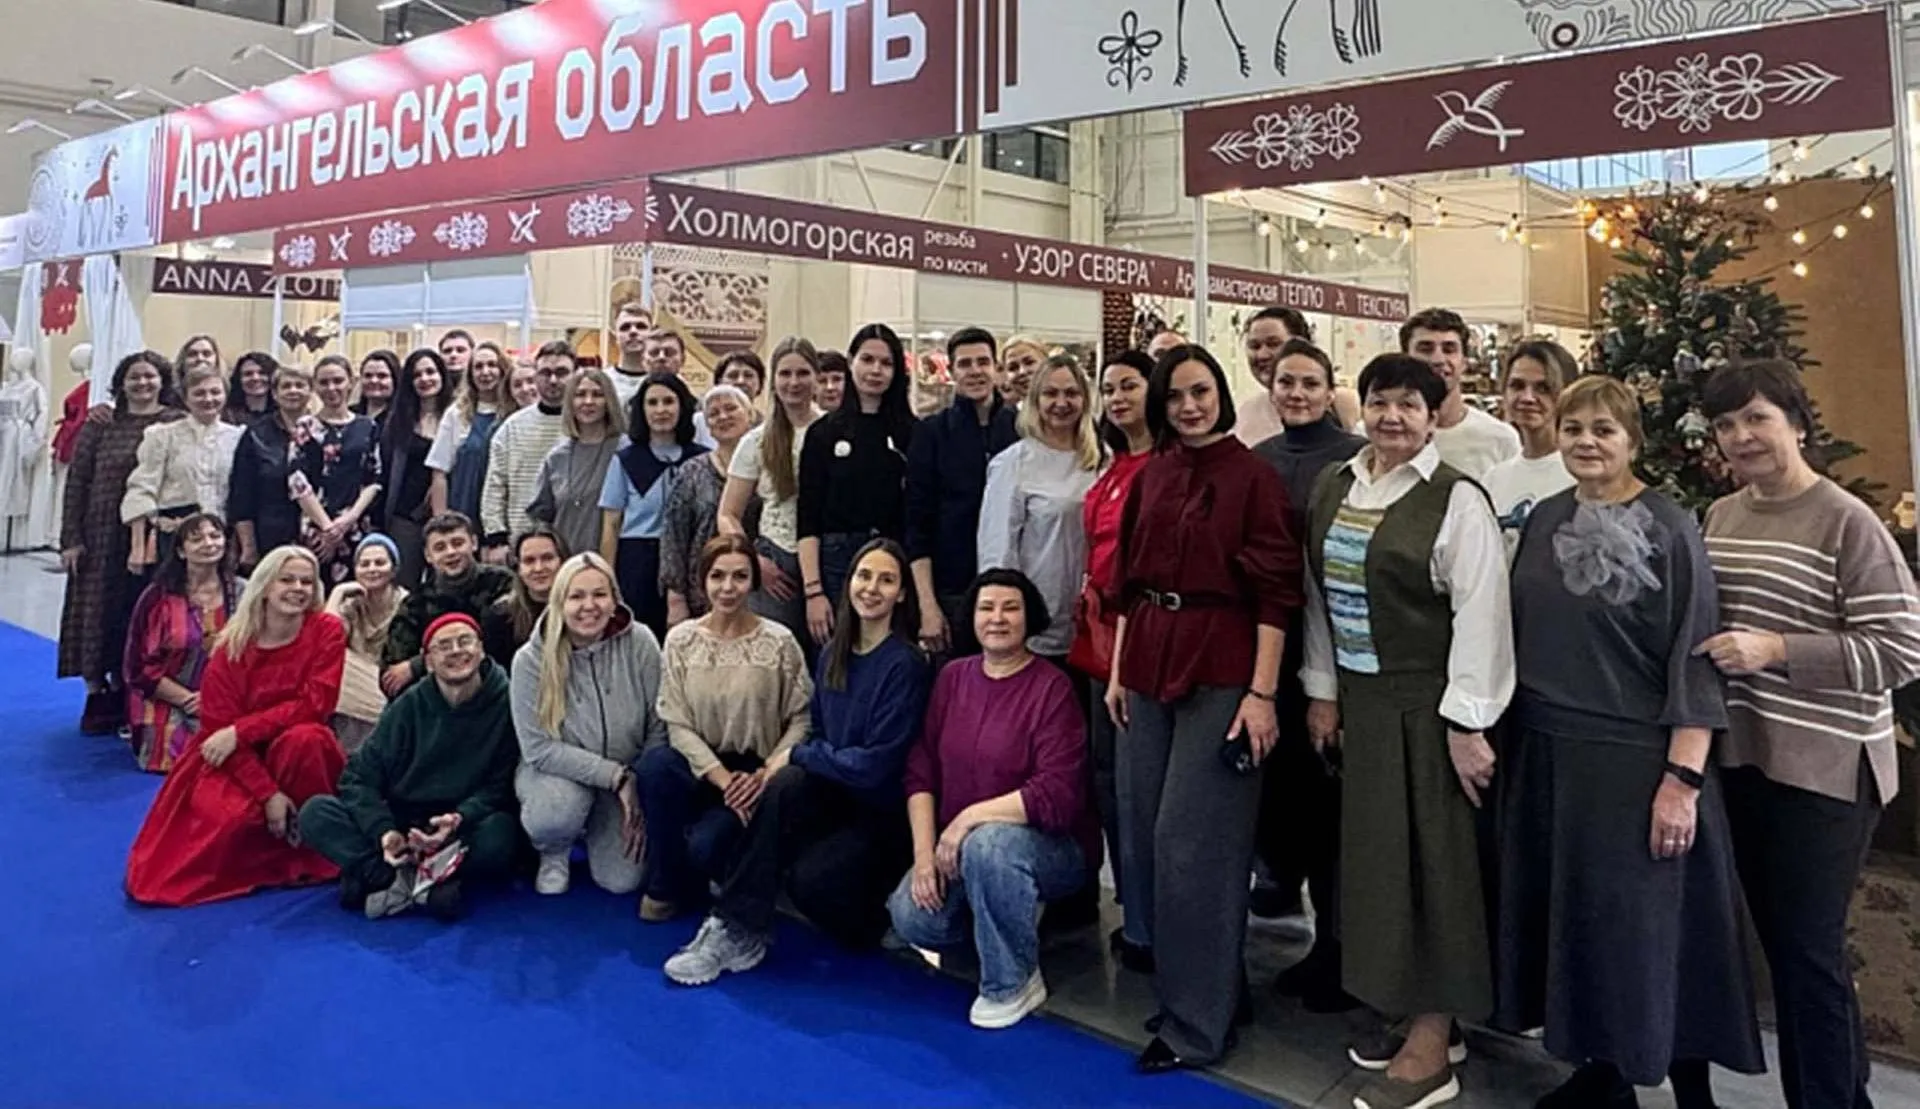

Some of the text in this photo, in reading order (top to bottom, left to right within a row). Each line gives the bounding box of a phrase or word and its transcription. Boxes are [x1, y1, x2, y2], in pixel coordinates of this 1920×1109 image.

[171, 0, 928, 231] Архангельская область
[668, 193, 914, 260] Холмогорская
[924, 229, 976, 248] резьба
[923, 256, 988, 275] по кости
[1014, 242, 1074, 277] УЗОР
[159, 265, 252, 292] ANNA
